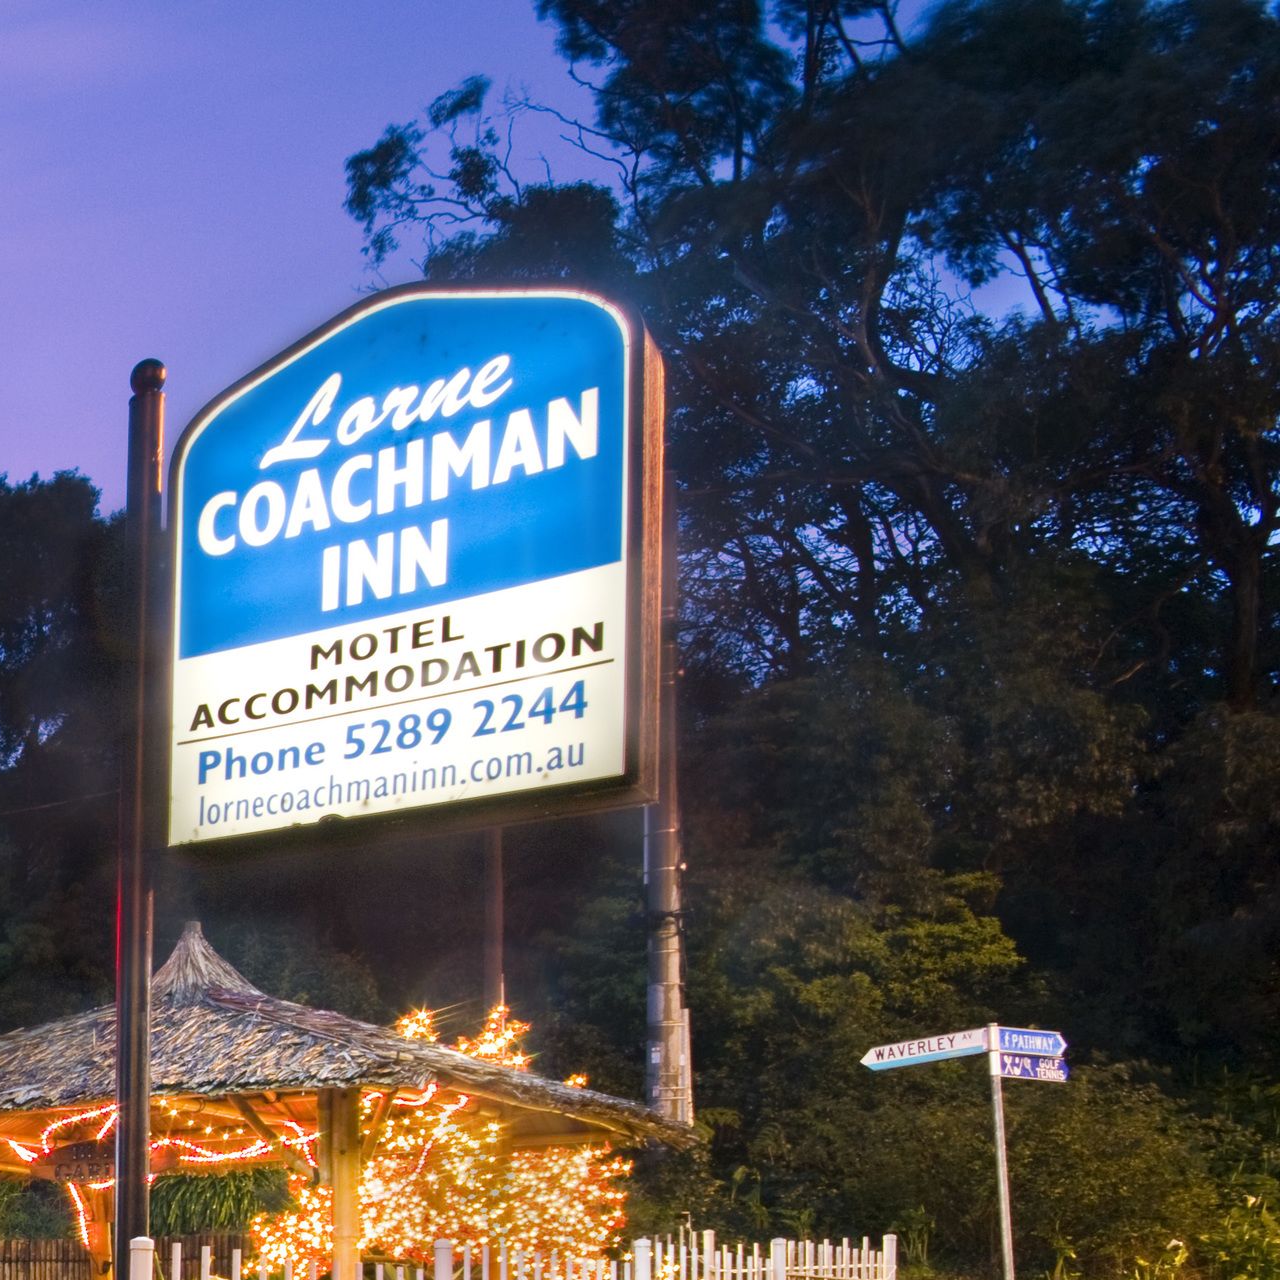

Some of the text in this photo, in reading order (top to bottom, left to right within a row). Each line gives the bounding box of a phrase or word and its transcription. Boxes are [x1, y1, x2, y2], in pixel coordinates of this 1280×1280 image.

[259, 353, 512, 470] Lorne
[197, 387, 599, 556] COACHMAN
[321, 518, 449, 612] INN
[189, 621, 605, 731] ACCOMMODATION
[310, 615, 465, 670] MOTEL
[197, 680, 588, 785] Phone 5289 2244
[198, 742, 586, 827] lornecoachmaninn.com.au
[874, 1032, 974, 1061] WAVERLEY AV
[1011, 1033, 1054, 1051] PATHWAY
[1035, 1067, 1065, 1081] TENNIS
[1039, 1058, 1060, 1070] GOLF
